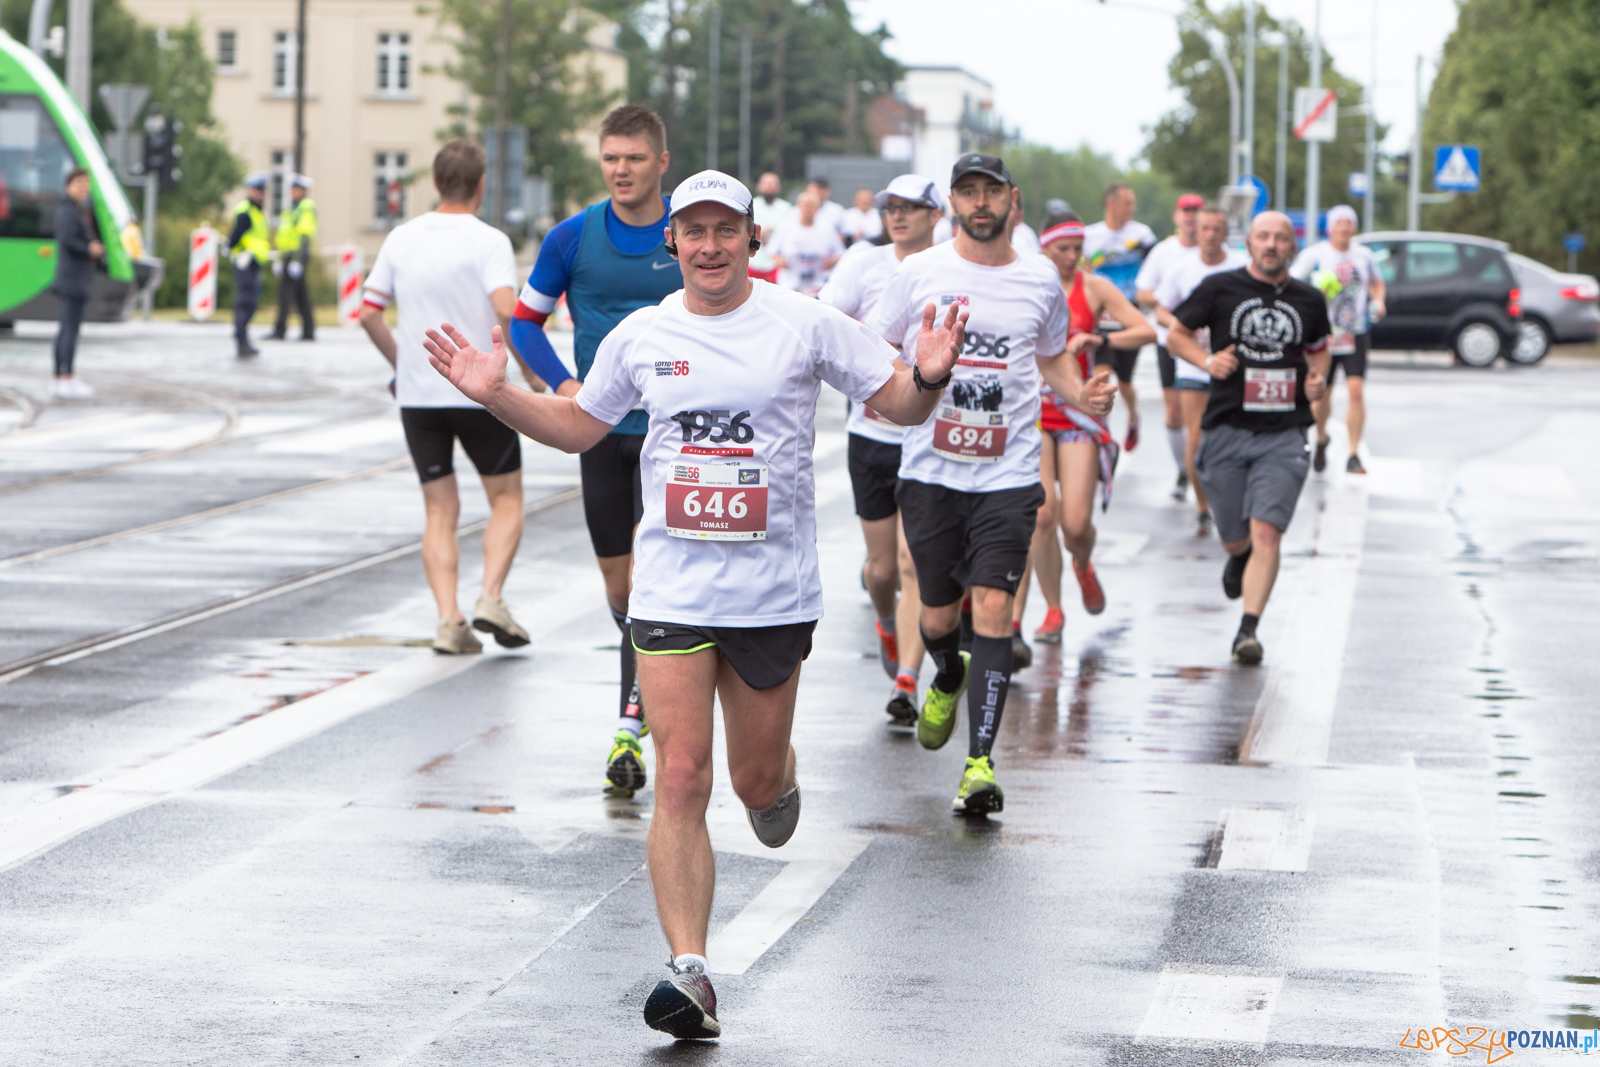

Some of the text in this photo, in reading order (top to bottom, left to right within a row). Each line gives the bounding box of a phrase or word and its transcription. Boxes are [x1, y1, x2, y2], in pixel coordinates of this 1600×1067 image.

[1257, 381, 1288, 400] 251
[670, 410, 754, 444] 1956
[948, 426, 993, 449] 694
[683, 490, 748, 519] 646
[700, 521, 729, 529] TOMASZ
